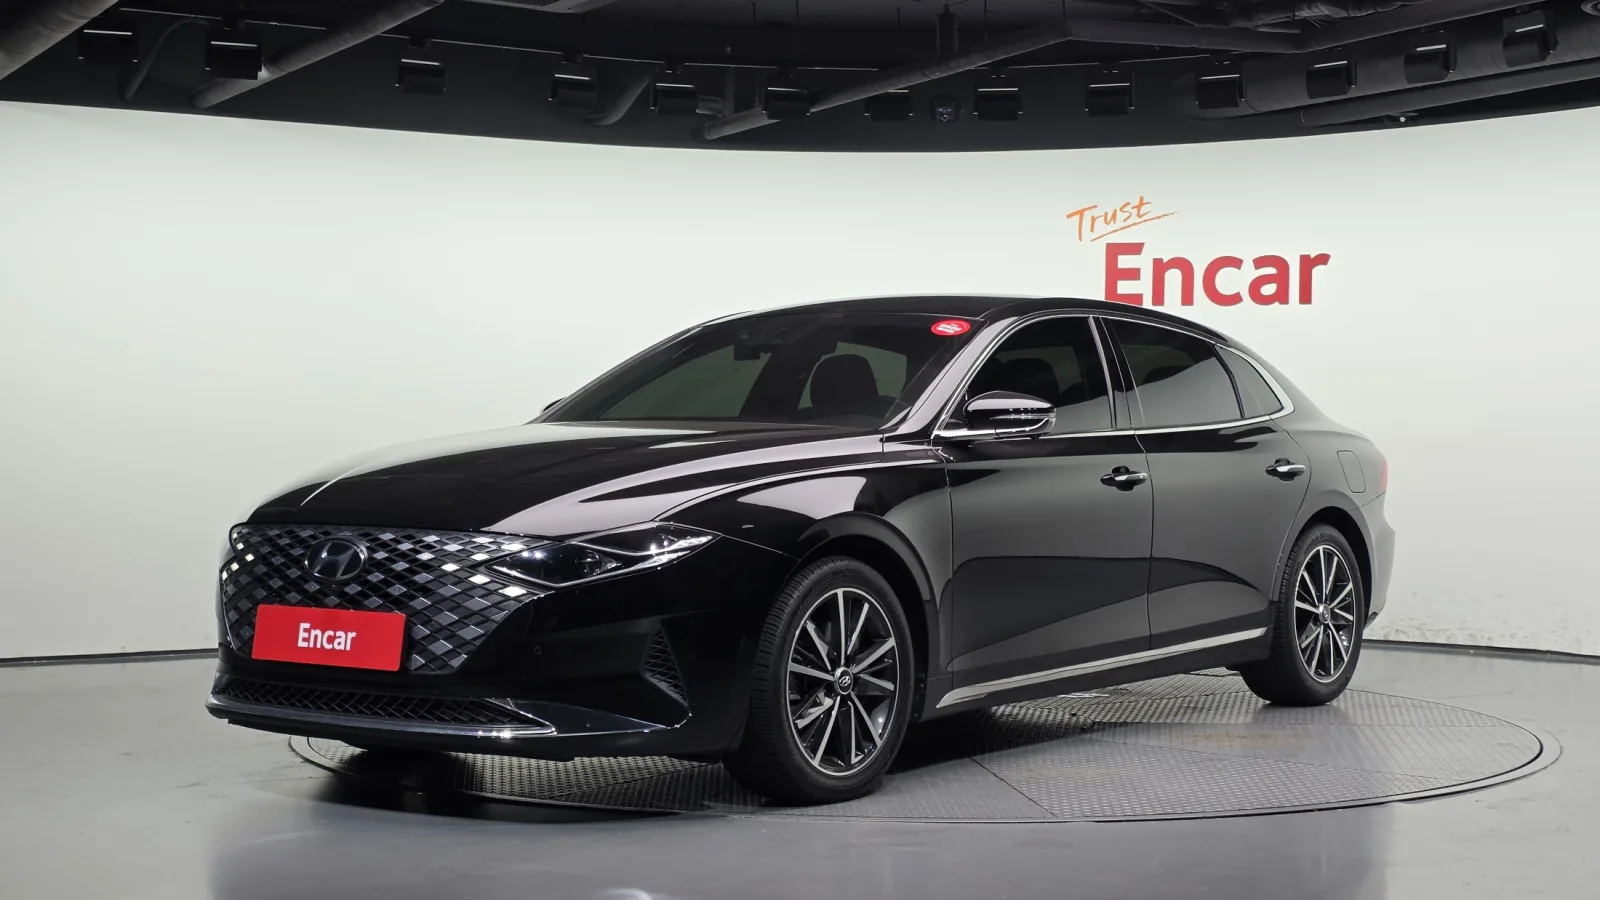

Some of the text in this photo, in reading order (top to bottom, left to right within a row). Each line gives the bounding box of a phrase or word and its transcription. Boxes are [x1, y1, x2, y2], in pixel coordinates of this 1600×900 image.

[1066, 196, 1152, 242] Trust
[1104, 242, 1331, 306] Encar
[297, 622, 357, 651] Encar
